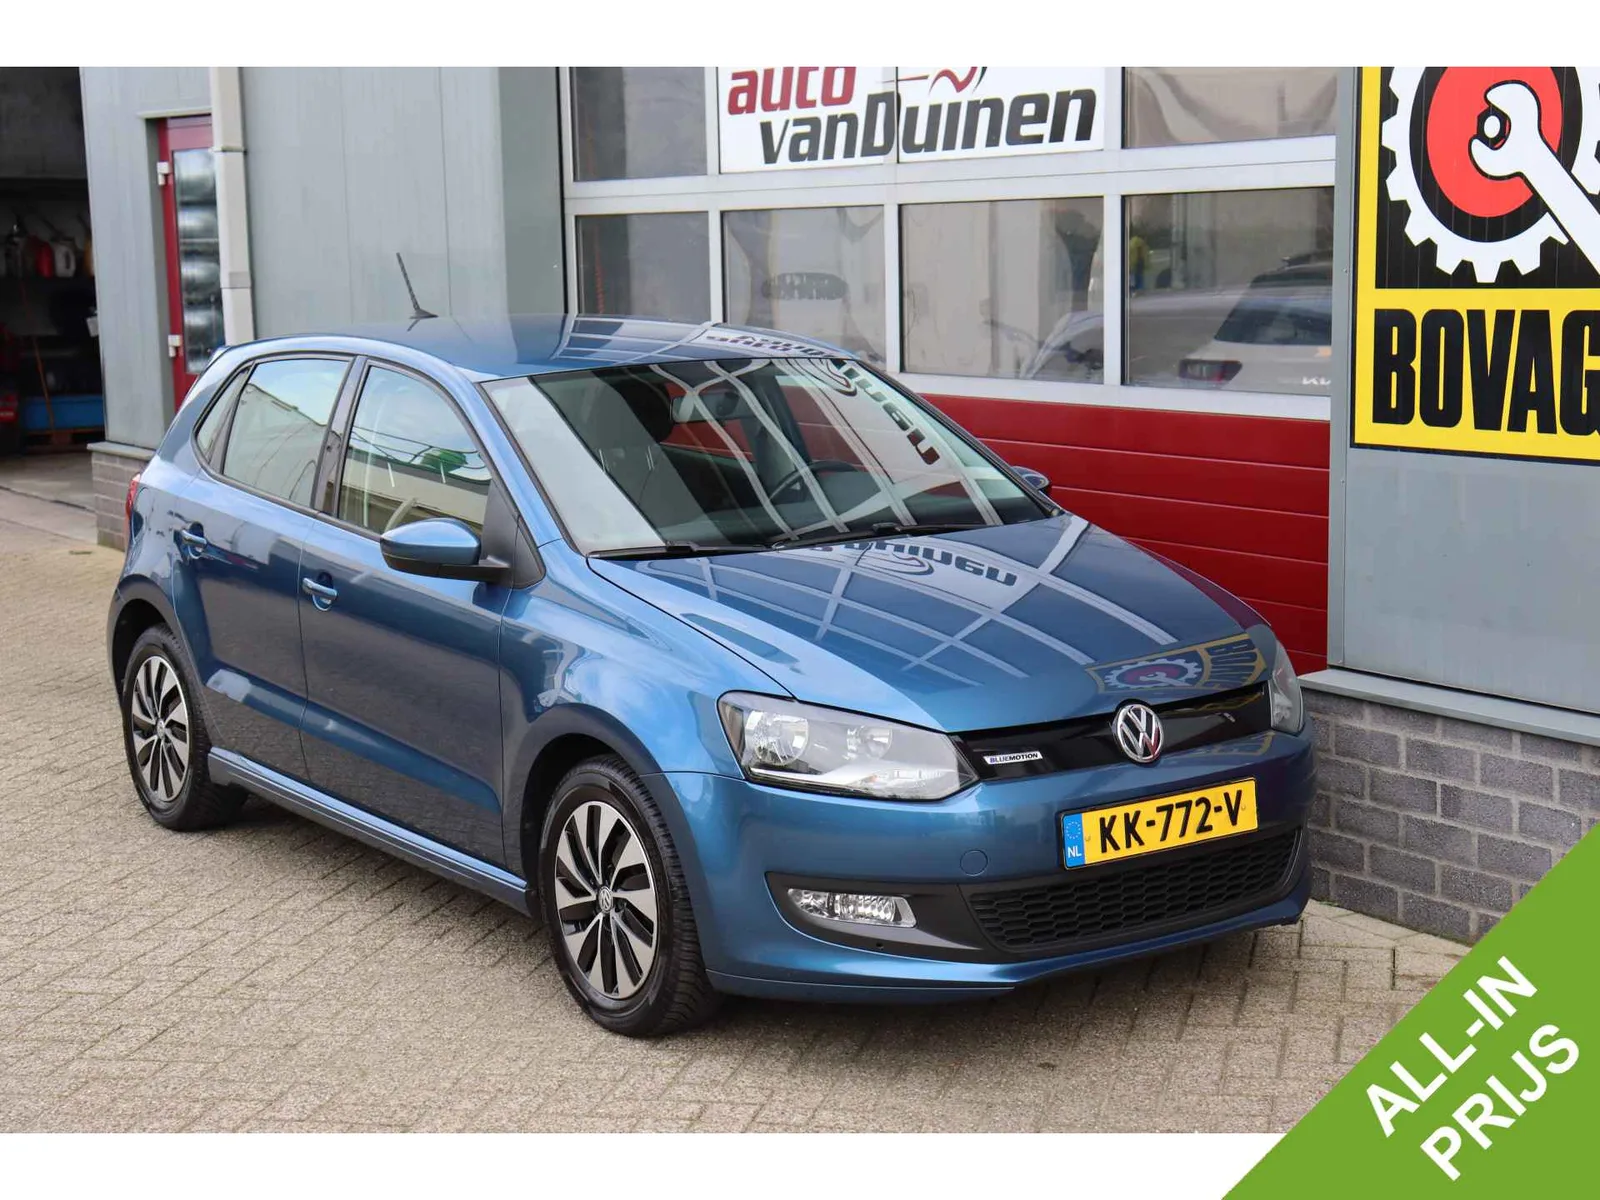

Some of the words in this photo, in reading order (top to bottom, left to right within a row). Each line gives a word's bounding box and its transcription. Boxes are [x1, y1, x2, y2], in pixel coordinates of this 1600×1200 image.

[1372, 308, 1600, 436] BOVAG
[989, 753, 1039, 764] BLUEMOTION
[1099, 789, 1243, 854] KK-772-V
[1067, 845, 1082, 858] NL
